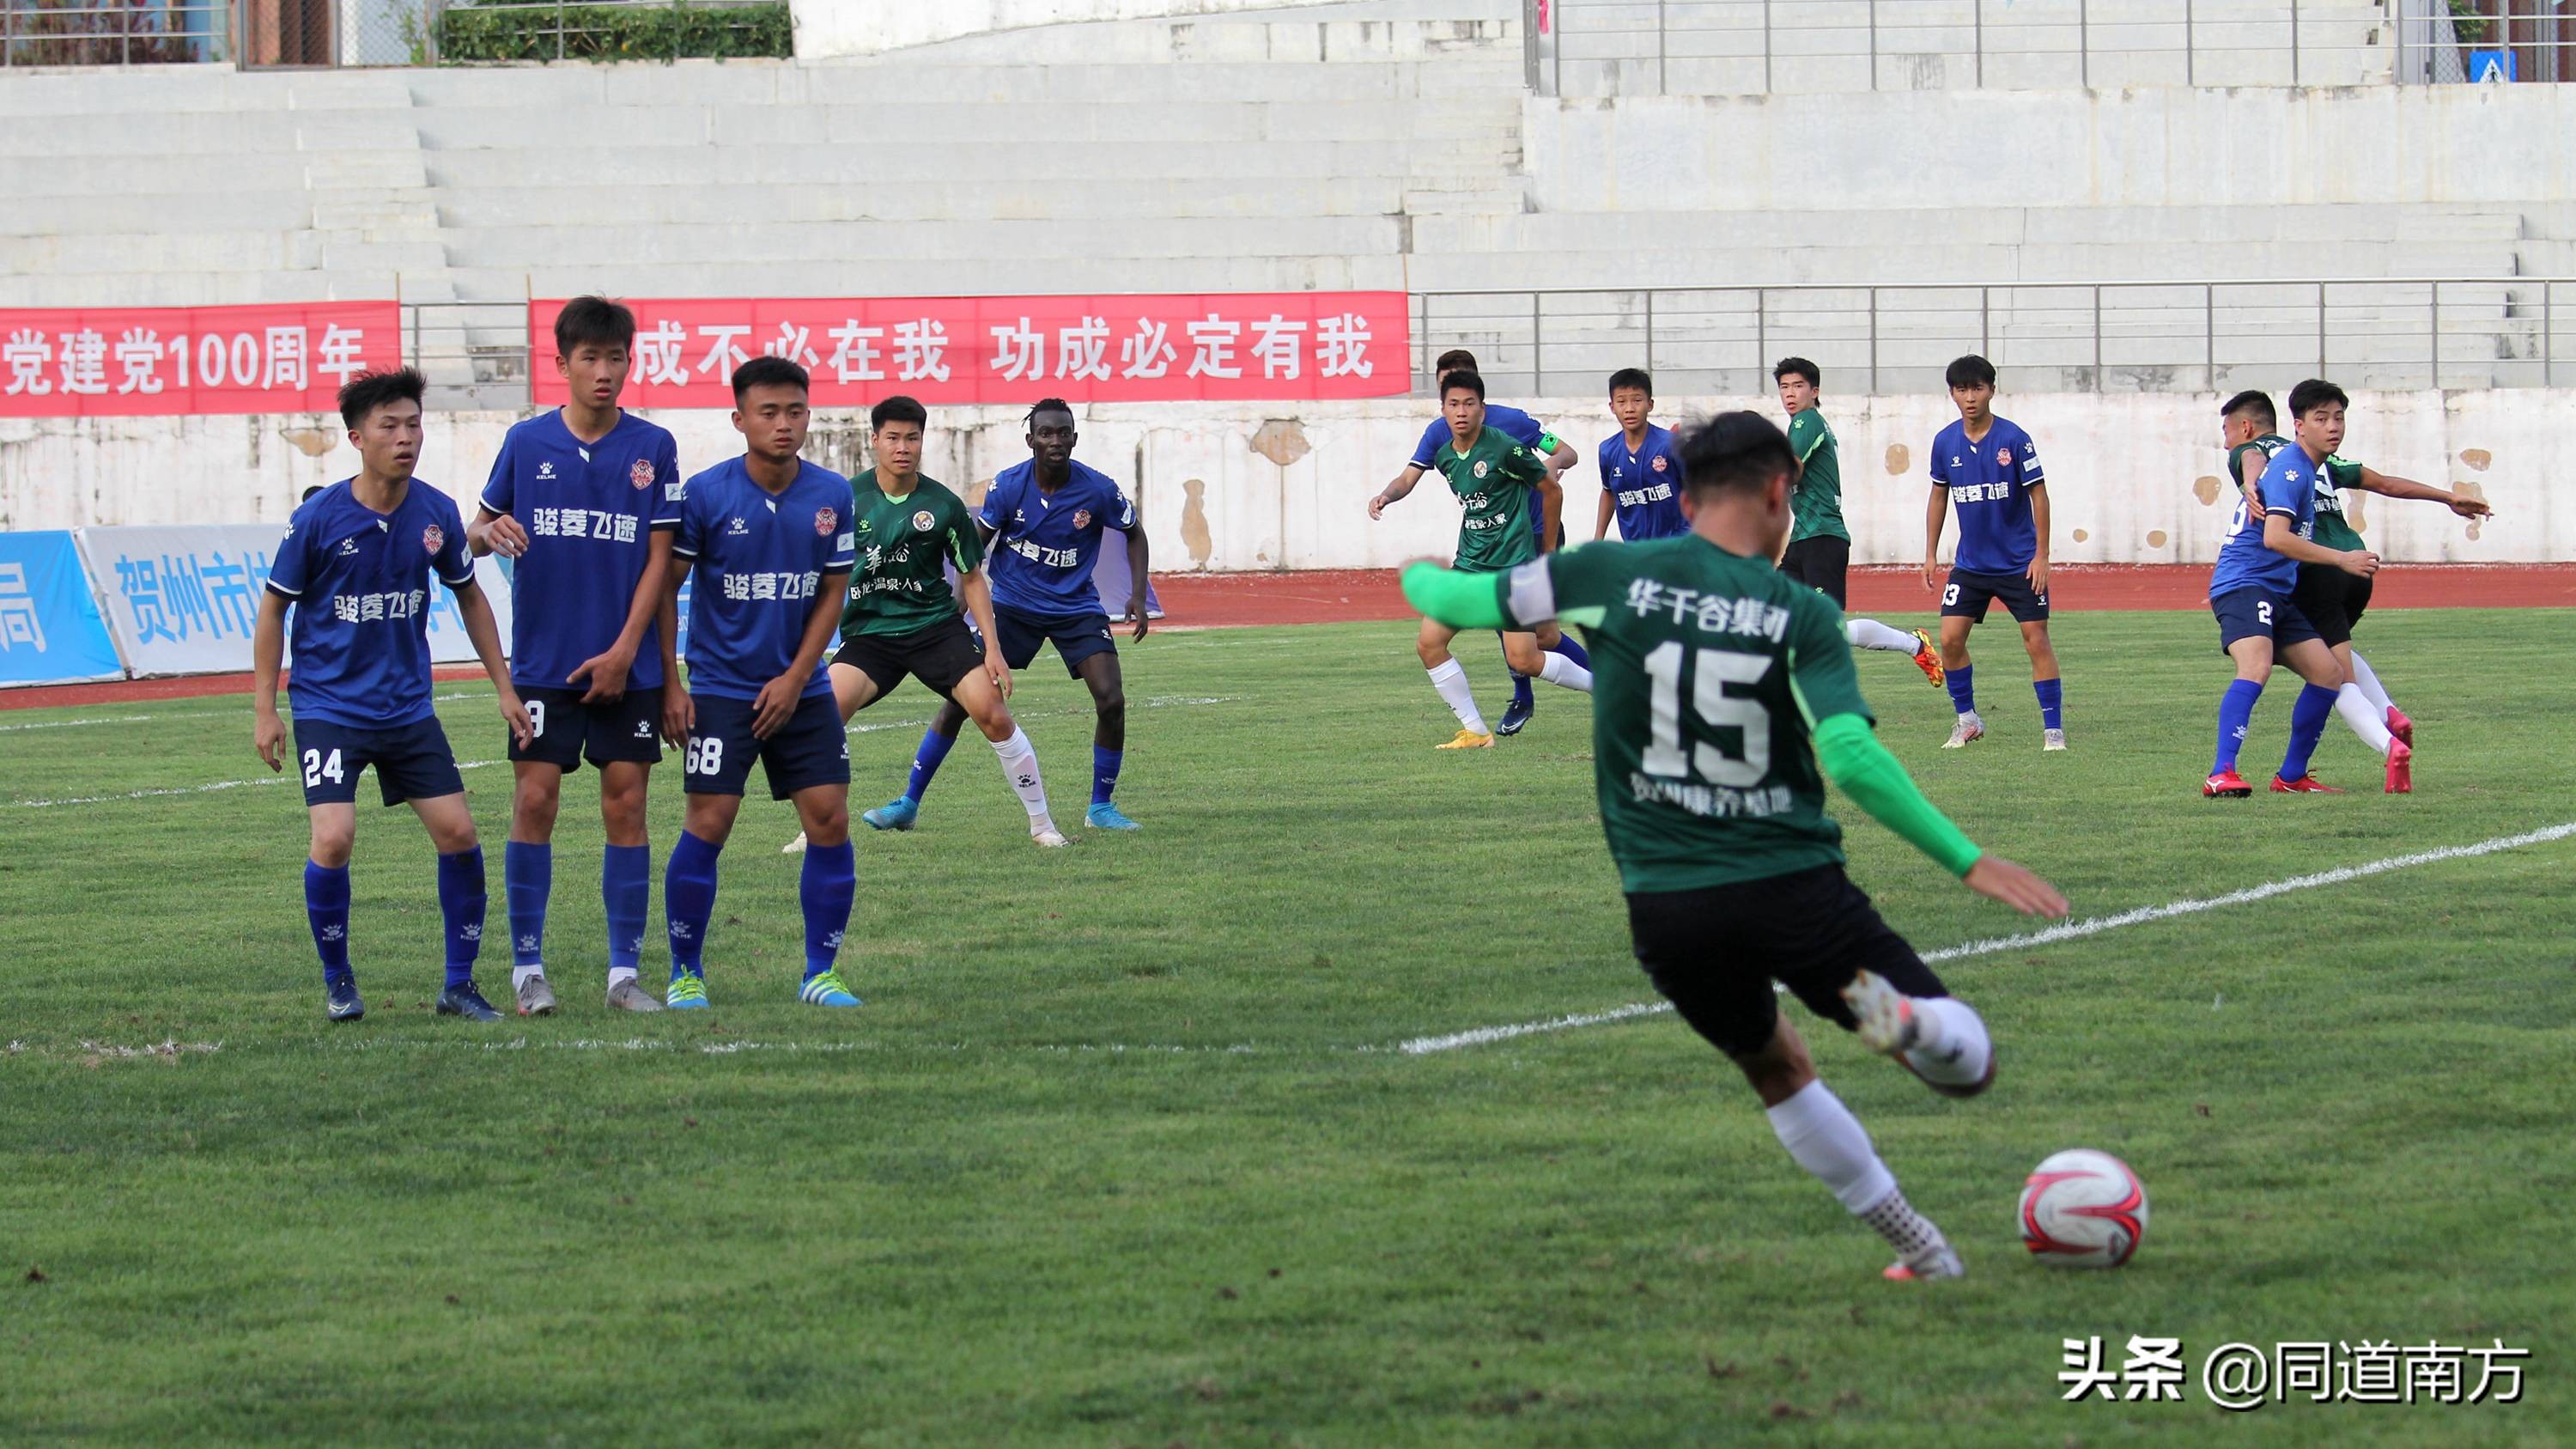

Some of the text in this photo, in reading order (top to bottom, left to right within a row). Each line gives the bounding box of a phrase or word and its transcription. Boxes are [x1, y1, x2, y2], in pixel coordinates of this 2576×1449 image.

[3, 323, 368, 396] 党建党100周年
[989, 313, 1374, 382] 功成必定有我
[1953, 482, 2009, 503] 骏菱飞速
[533, 508, 639, 543] 骏菱飞速
[724, 570, 821, 601] 骏菱飞速
[2257, 600, 2273, 625] 2
[1642, 640, 1774, 788] 15
[303, 748, 343, 788] 24
[686, 737, 723, 776] 68
